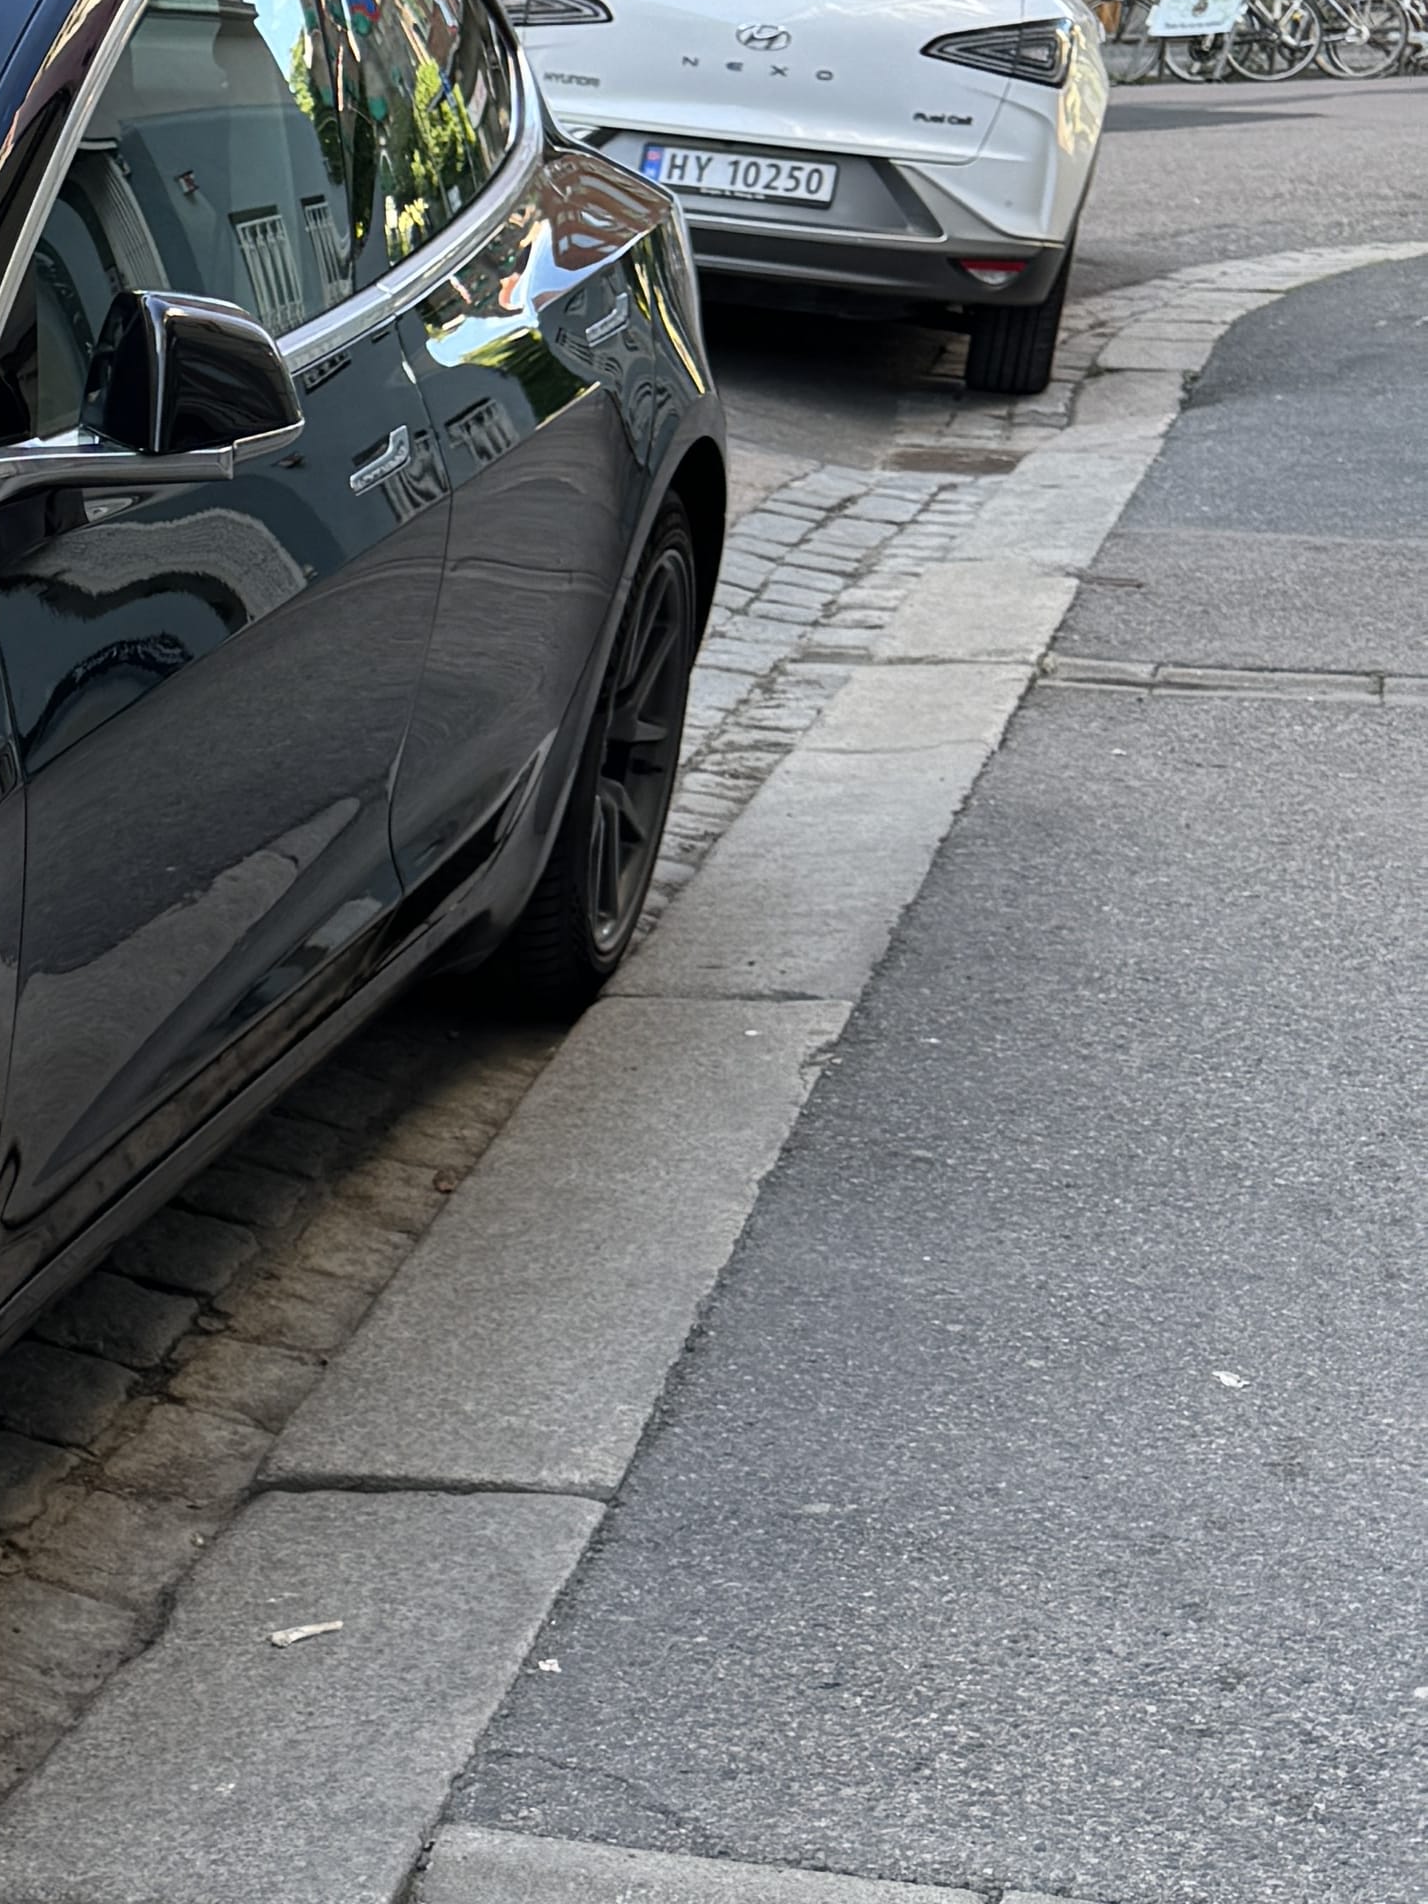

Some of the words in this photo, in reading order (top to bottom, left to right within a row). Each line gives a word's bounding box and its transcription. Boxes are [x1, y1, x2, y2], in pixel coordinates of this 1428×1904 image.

[681, 55, 835, 82] NEXO
[666, 152, 714, 184] HY
[728, 159, 825, 196] 10250
